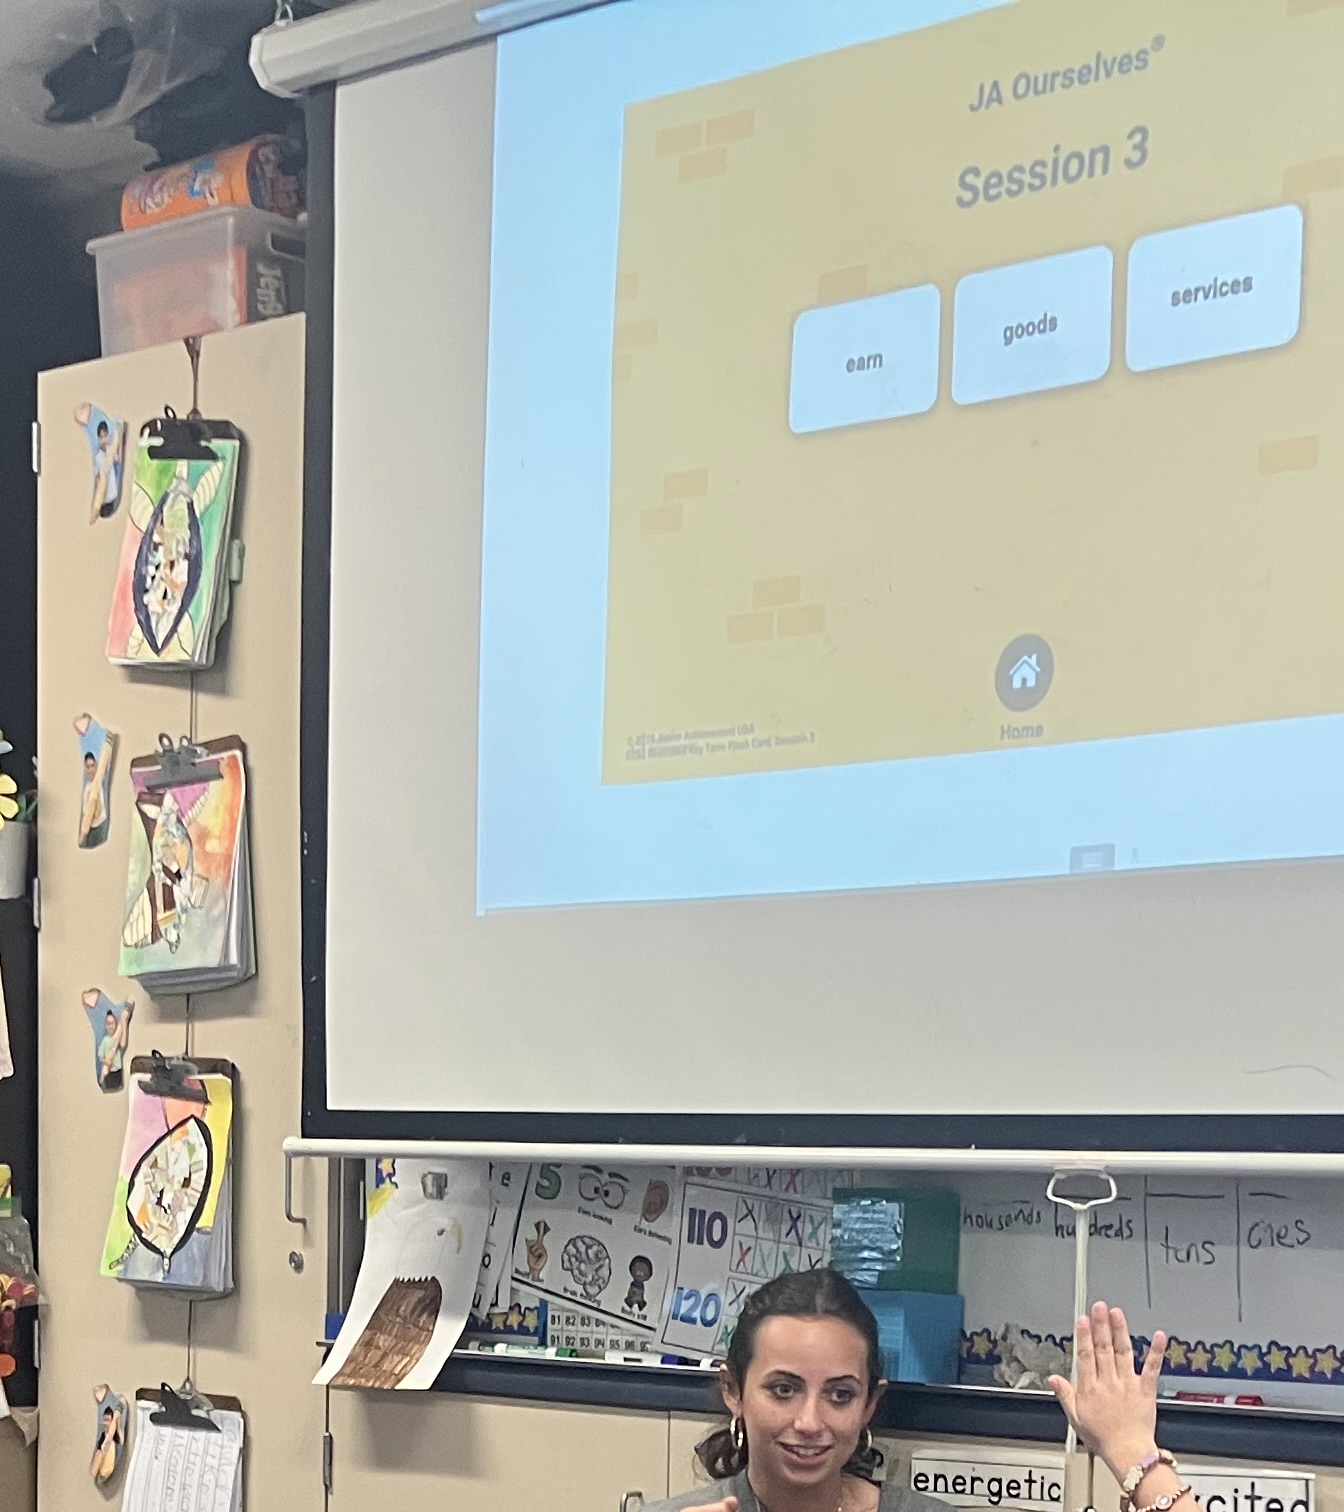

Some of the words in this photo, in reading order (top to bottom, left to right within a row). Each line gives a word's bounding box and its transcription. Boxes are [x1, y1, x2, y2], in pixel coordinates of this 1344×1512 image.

[969, 79, 1004, 113] JA
[955, 143, 1111, 209] Session
[1123, 125, 1150, 170] 3
[1170, 273, 1254, 308] services
[1002, 312, 1058, 346] goods
[845, 351, 884, 374] earn
[999, 723, 1044, 741] Home
[535, 1163, 562, 1200] 5
[687, 1206, 729, 1250] 110
[962, 1205, 1043, 1232] housands
[1055, 1212, 1135, 1240] hudreds
[671, 1286, 722, 1328] 120
[564, 1335, 576, 1348] 92
[579, 1336, 591, 1349] 93
[912, 1467, 1063, 1506] energetic
